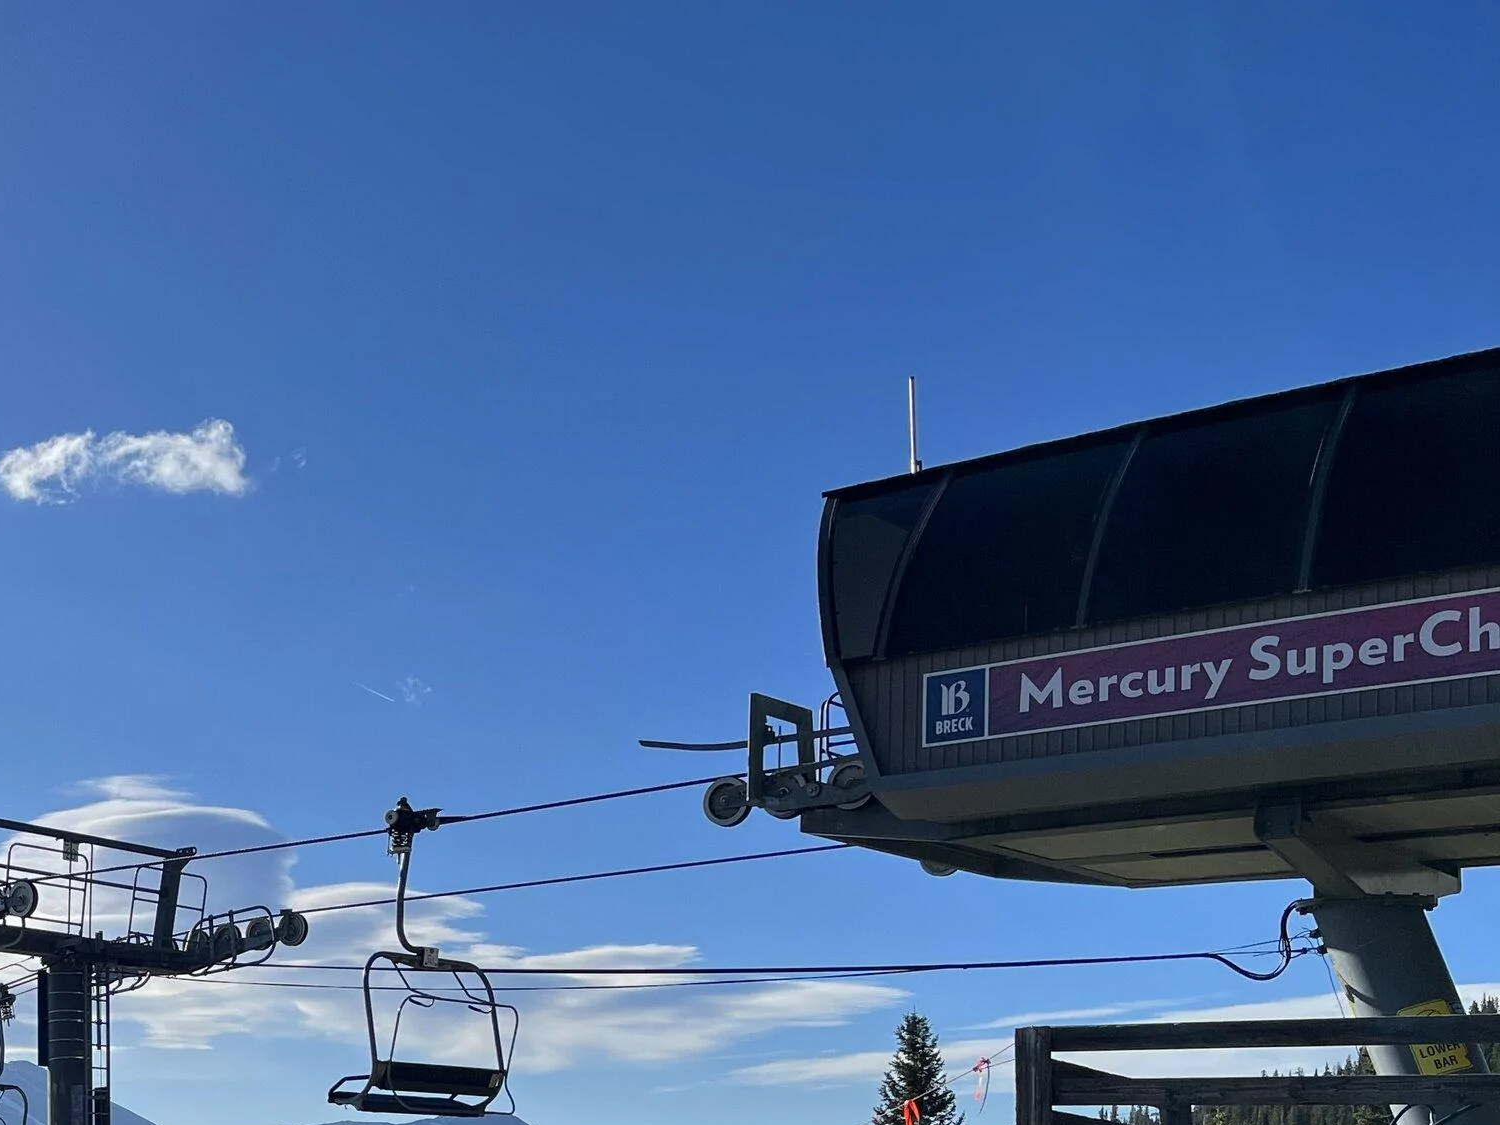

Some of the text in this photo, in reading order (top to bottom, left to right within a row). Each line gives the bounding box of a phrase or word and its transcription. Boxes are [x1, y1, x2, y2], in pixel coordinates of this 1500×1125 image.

[1018, 606, 1500, 713] Mercury SuperCh
[935, 715, 974, 735] BRECK
[1419, 1043, 1460, 1059] LOWER
[1433, 1055, 1459, 1070] BAR
